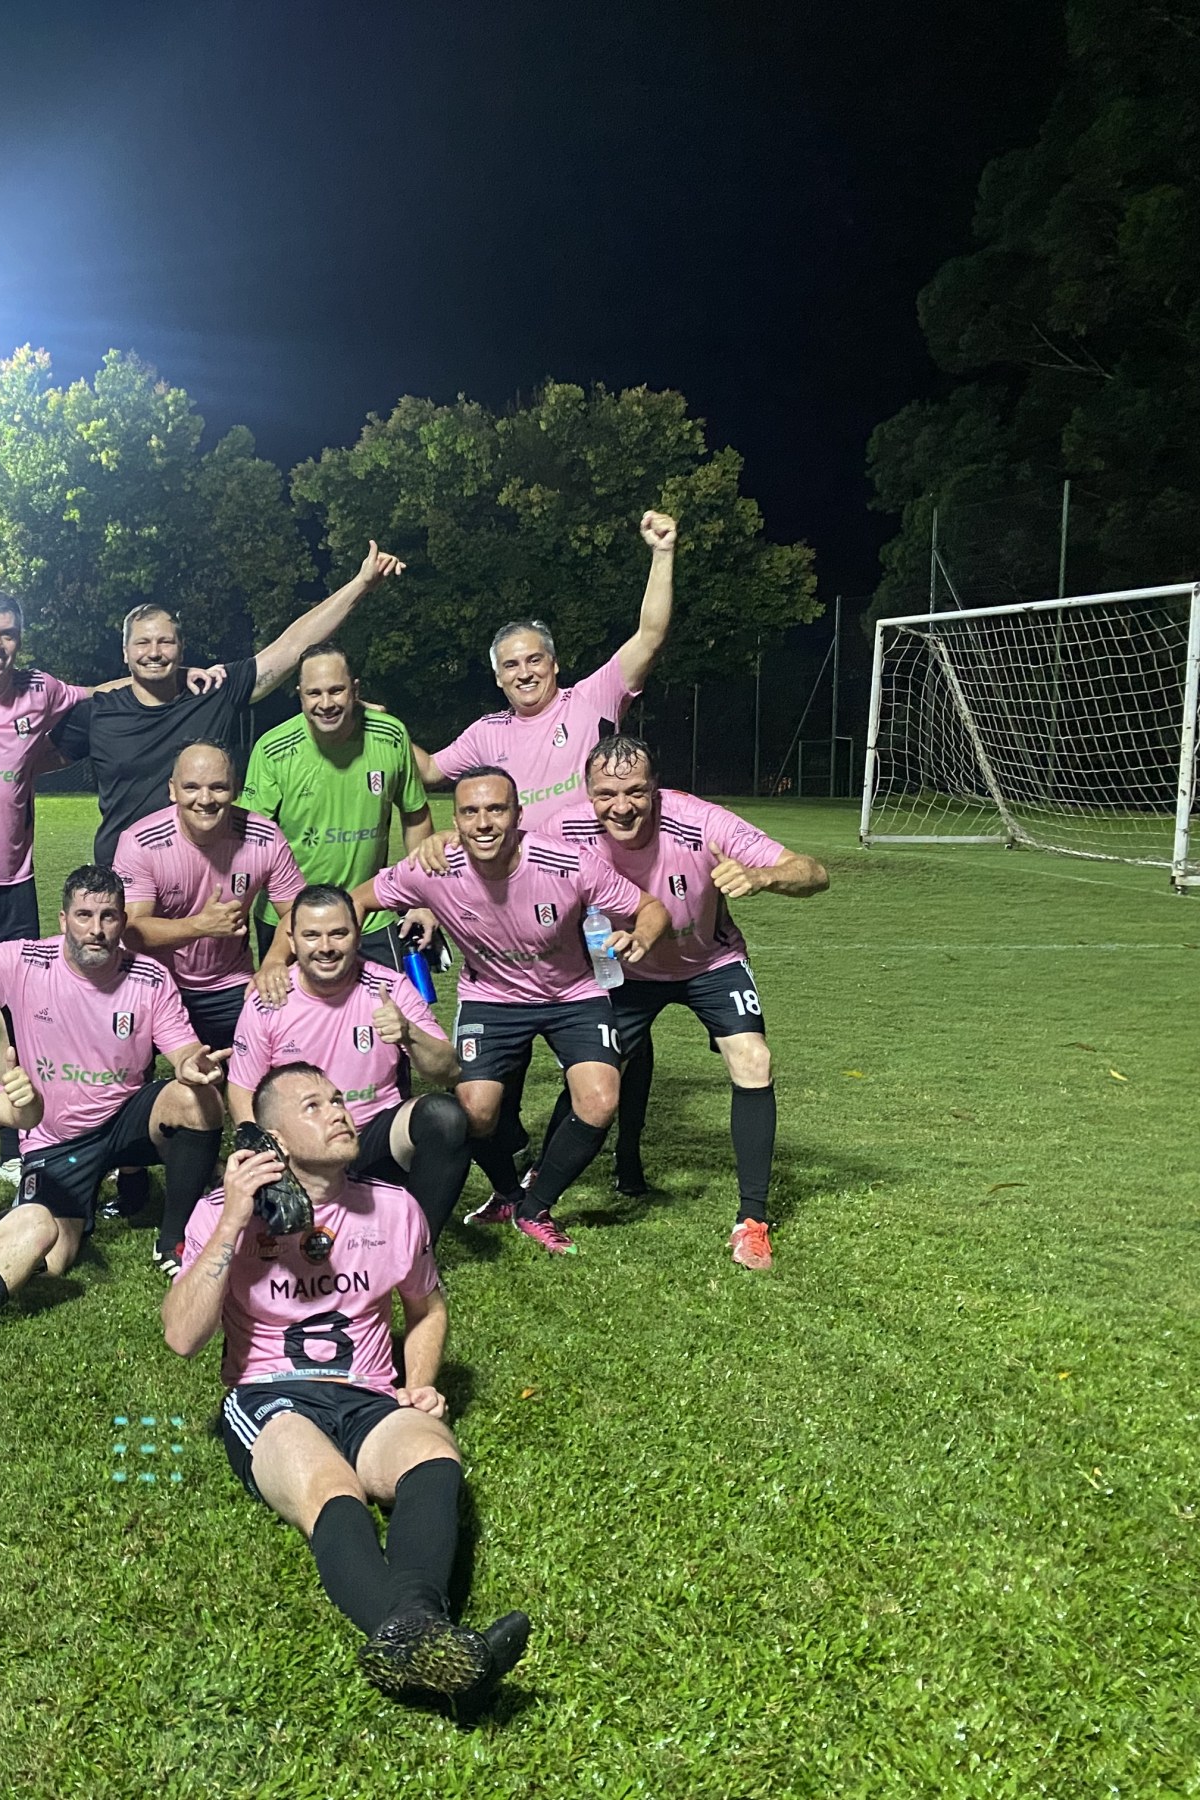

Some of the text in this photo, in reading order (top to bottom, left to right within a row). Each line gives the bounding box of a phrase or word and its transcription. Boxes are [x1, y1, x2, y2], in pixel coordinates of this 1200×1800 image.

[519, 770, 582, 806] Sicredi
[730, 990, 762, 1016] 18
[61, 1064, 128, 1085] Sicredi
[270, 1270, 370, 1300] MAICON
[283, 1311, 355, 1370] 6
